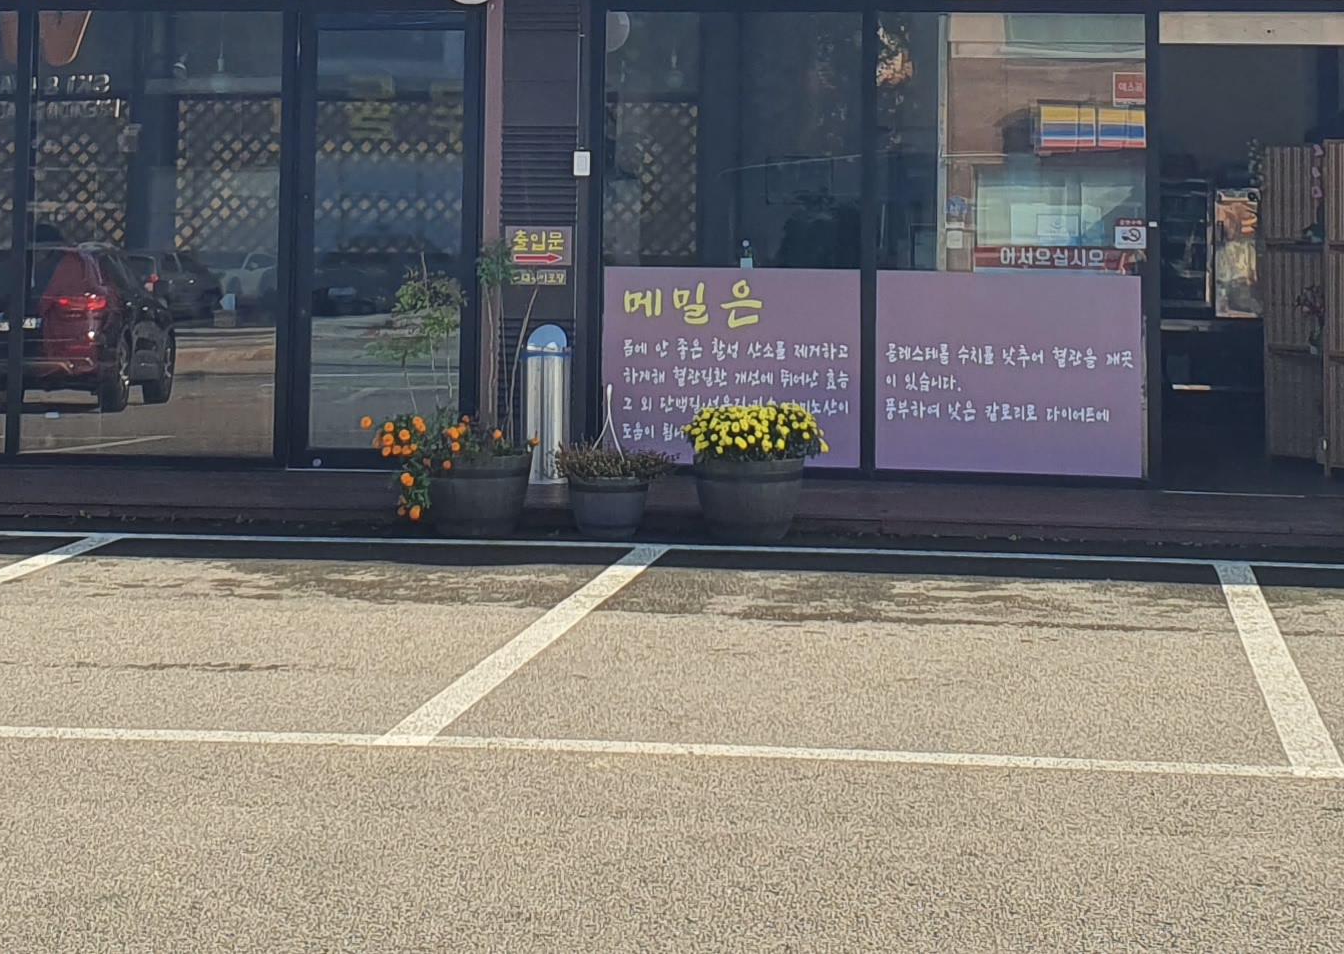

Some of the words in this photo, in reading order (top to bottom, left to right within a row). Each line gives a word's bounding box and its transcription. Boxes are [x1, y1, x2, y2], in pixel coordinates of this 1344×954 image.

[513, 229, 565, 252] 출입문
[1000, 246, 1105, 267] 어서오십시오
[623, 279, 763, 329] 메밀은
[622, 339, 648, 357] 몸에
[655, 339, 670, 357] 안
[677, 337, 703, 361] 좋은
[711, 337, 739, 362] 활성
[747, 339, 786, 361] 산소를
[793, 342, 849, 361] 제거하고
[885, 342, 950, 366] 콜레스테롤
[957, 345, 994, 366] 수치를
[1001, 344, 1045, 368] 낮추어
[1051, 346, 1098, 369] 혈관을
[623, 367, 666, 385] 하게해
[672, 365, 728, 388] 혈관질환
[734, 368, 774, 386] 개선에
[780, 368, 820, 387] 뛰어난
[825, 368, 850, 390] 효능
[885, 373, 897, 388] 이
[904, 371, 962, 392] 있습니다.
[622, 396, 633, 410] 그
[641, 395, 653, 412] 외
[885, 397, 940, 422] 풍부하여
[947, 400, 977, 423] 낮은
[984, 401, 1038, 423] 칼로리로
[1046, 405, 1111, 423] 다이어트에
[622, 422, 655, 440] 도움이
[662, 422, 686, 443] 됩니
